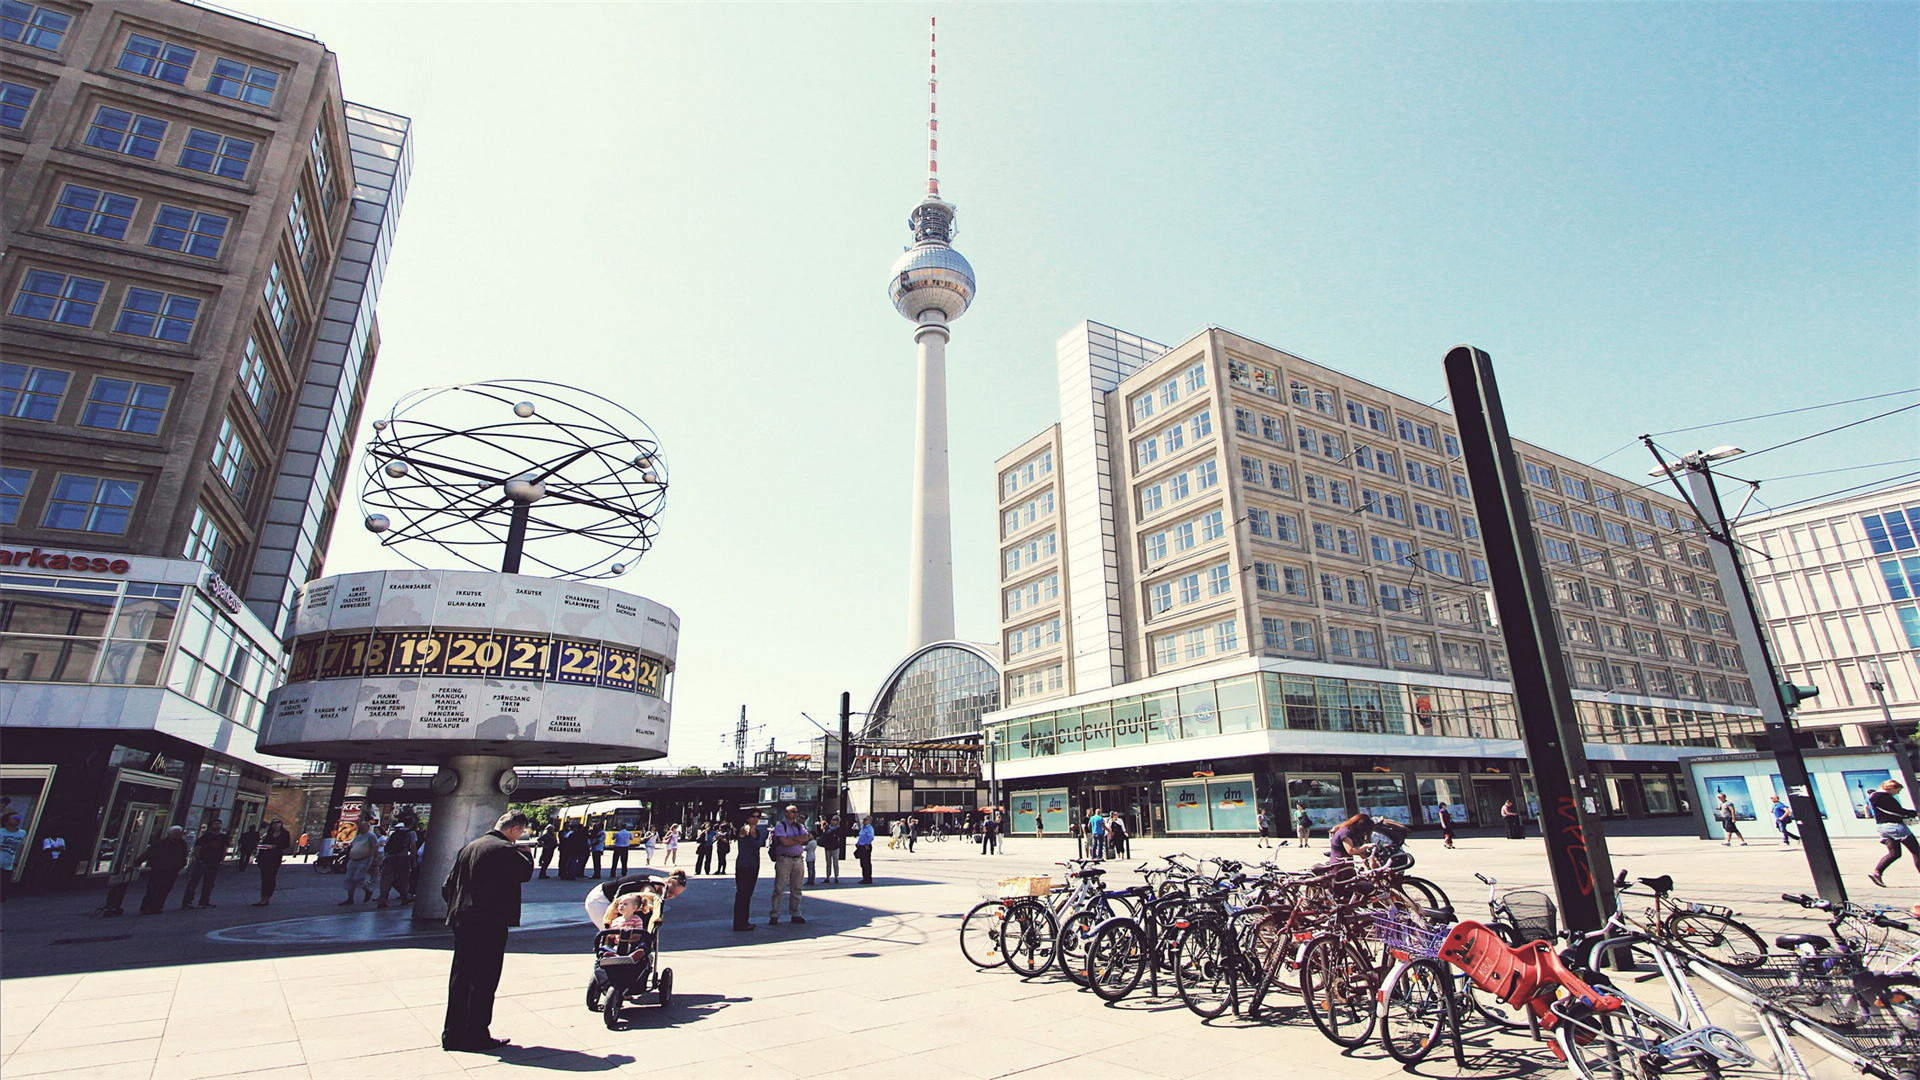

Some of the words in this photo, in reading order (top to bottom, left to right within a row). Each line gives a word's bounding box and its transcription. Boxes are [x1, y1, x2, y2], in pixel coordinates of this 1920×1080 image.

[515, 588, 542, 596] JAKUTSK
[315, 641, 344, 669] 17
[352, 639, 386, 667] 18
[400, 638, 441, 665] 19
[448, 639, 503, 667] 20
[510, 642, 550, 670] 21
[561, 647, 602, 676] 22
[606, 654, 636, 682] 23
[638, 662, 658, 688] 24
[1058, 713, 1159, 744] CLOCKHOUSE
[1179, 789, 1195, 802] dm
[1224, 787, 1242, 800] dm
[1021, 799, 1032, 809] dm
[1050, 797, 1061, 808] dm
